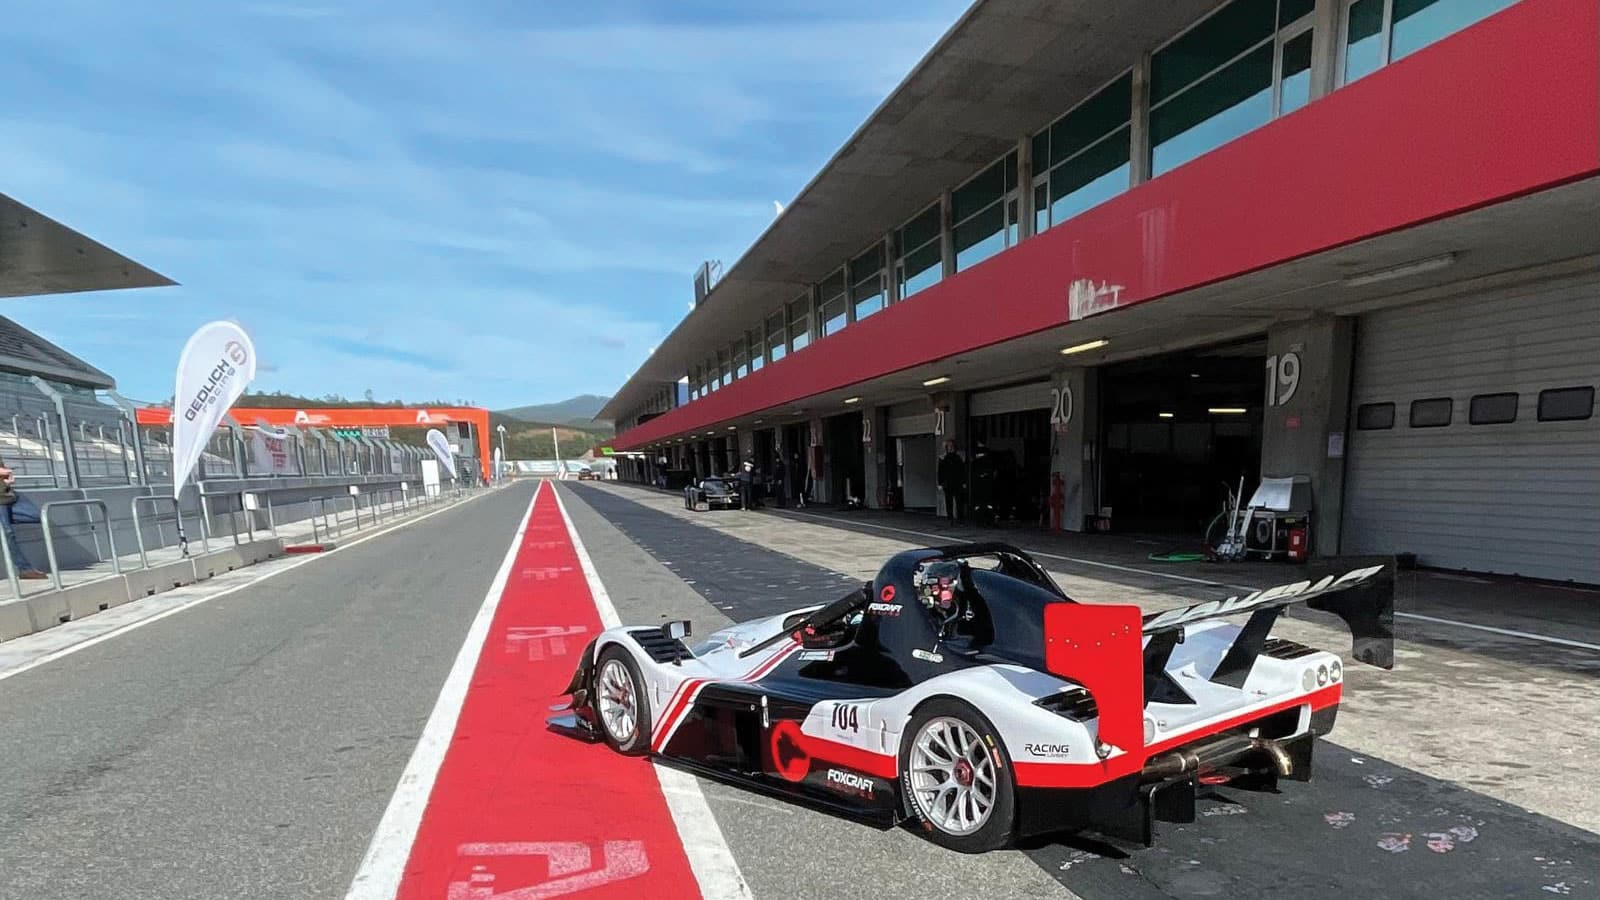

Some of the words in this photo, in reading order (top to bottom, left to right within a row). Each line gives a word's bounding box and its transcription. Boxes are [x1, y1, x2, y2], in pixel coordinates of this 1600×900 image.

[184, 358, 230, 422] GEDLICH
[1265, 352, 1300, 407] 19
[1050, 386, 1073, 425] 20
[862, 418, 872, 443] 22
[934, 407, 945, 436] 21
[831, 702, 859, 734] 704
[1024, 743, 1070, 757] RACING
[827, 768, 874, 793] FOXCRAFT
